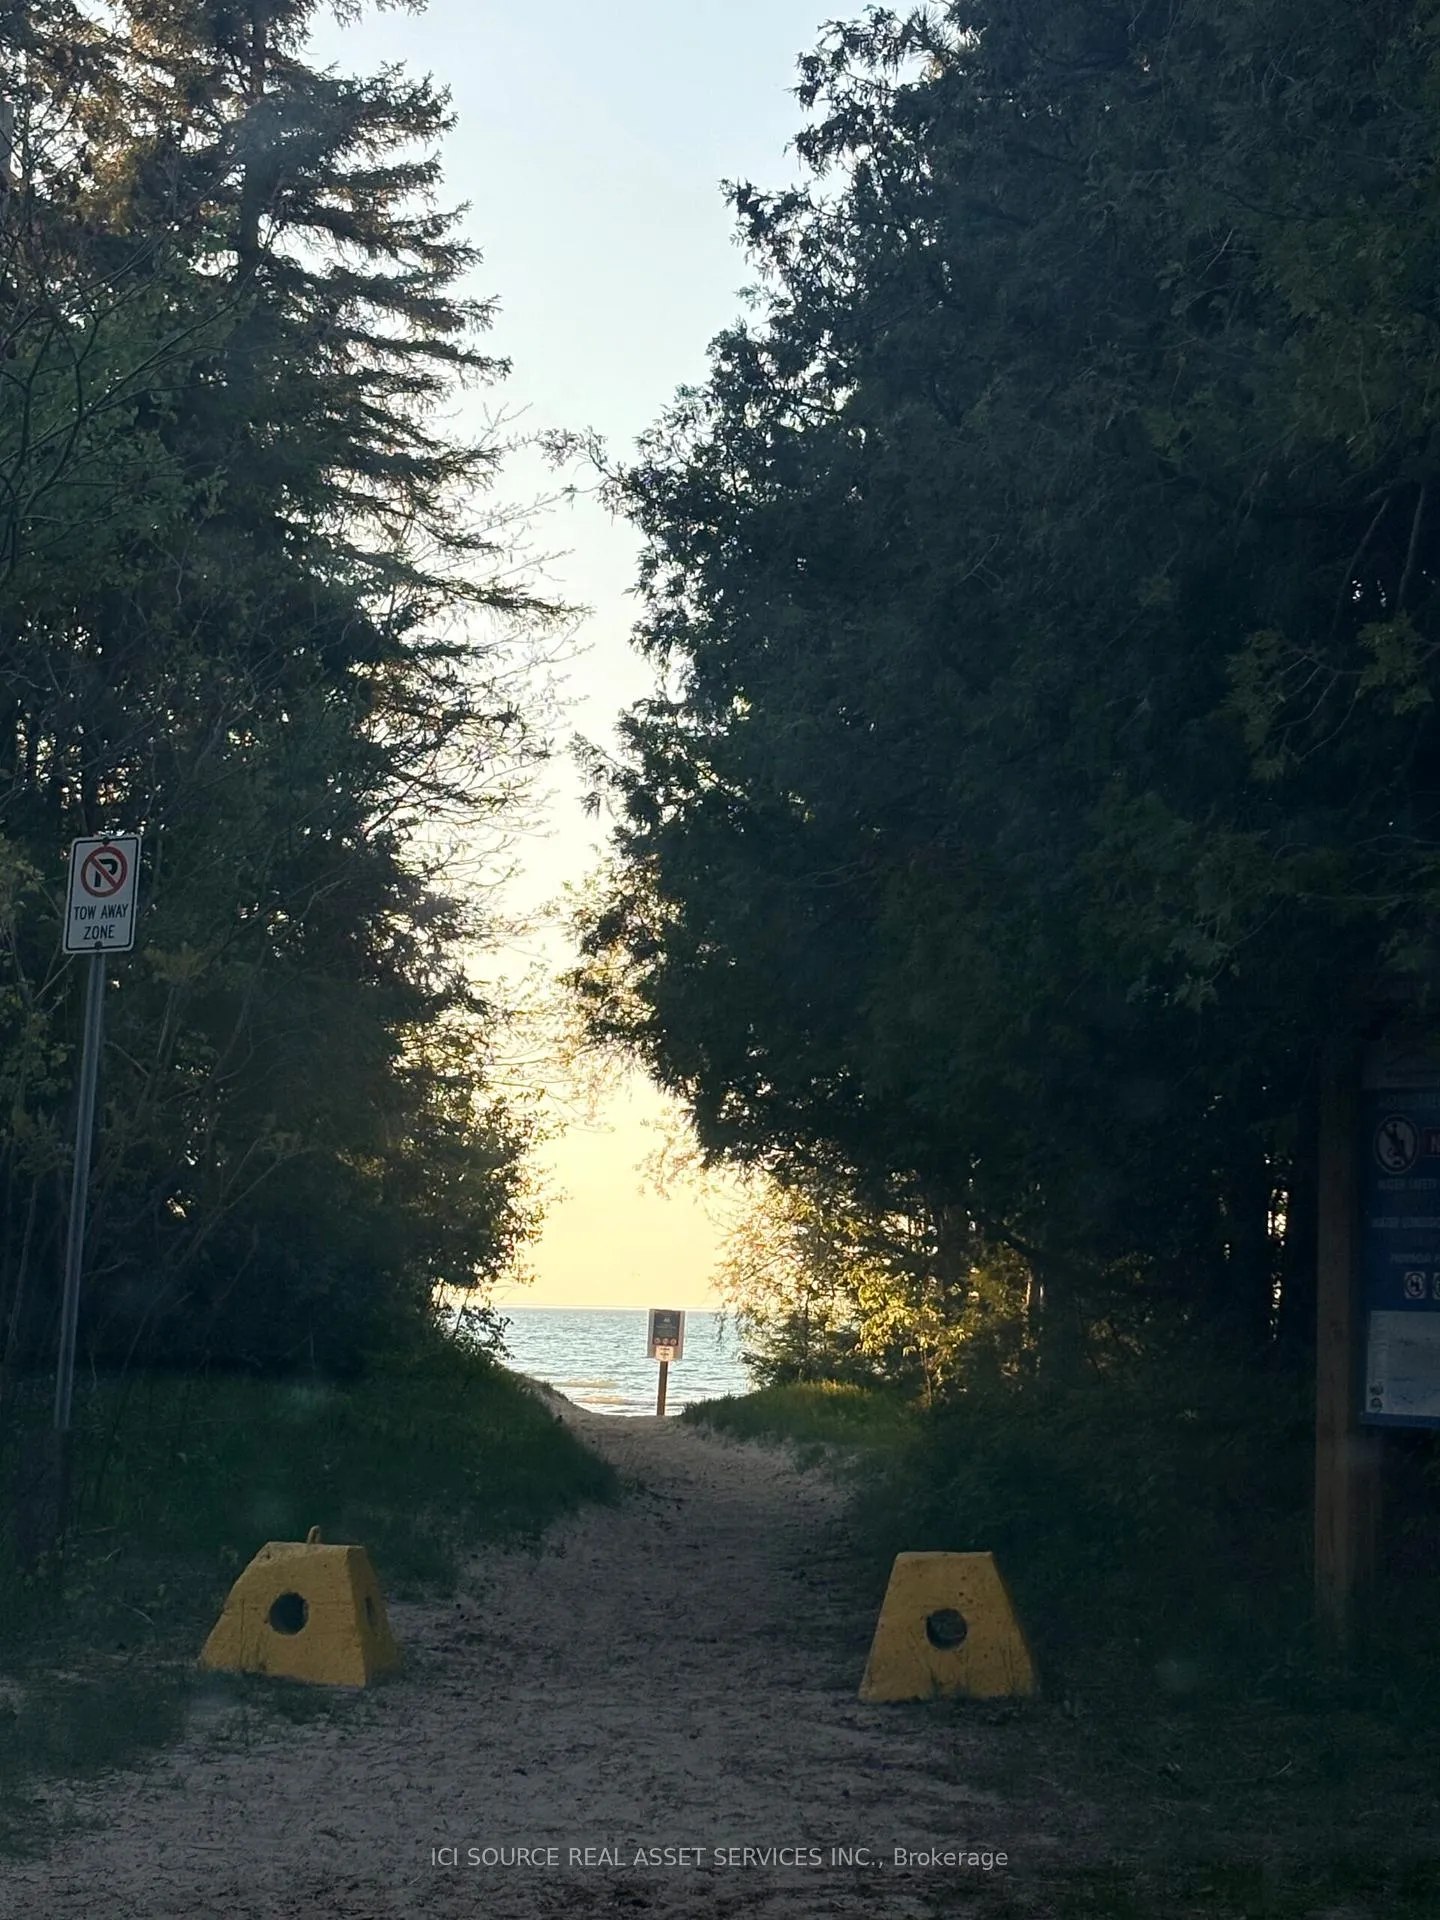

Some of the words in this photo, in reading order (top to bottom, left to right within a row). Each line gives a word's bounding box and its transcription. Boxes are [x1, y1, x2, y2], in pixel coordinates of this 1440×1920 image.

[74, 905, 97, 921] TOW
[100, 903, 129, 919] AWAY
[83, 924, 116, 940] ZONE
